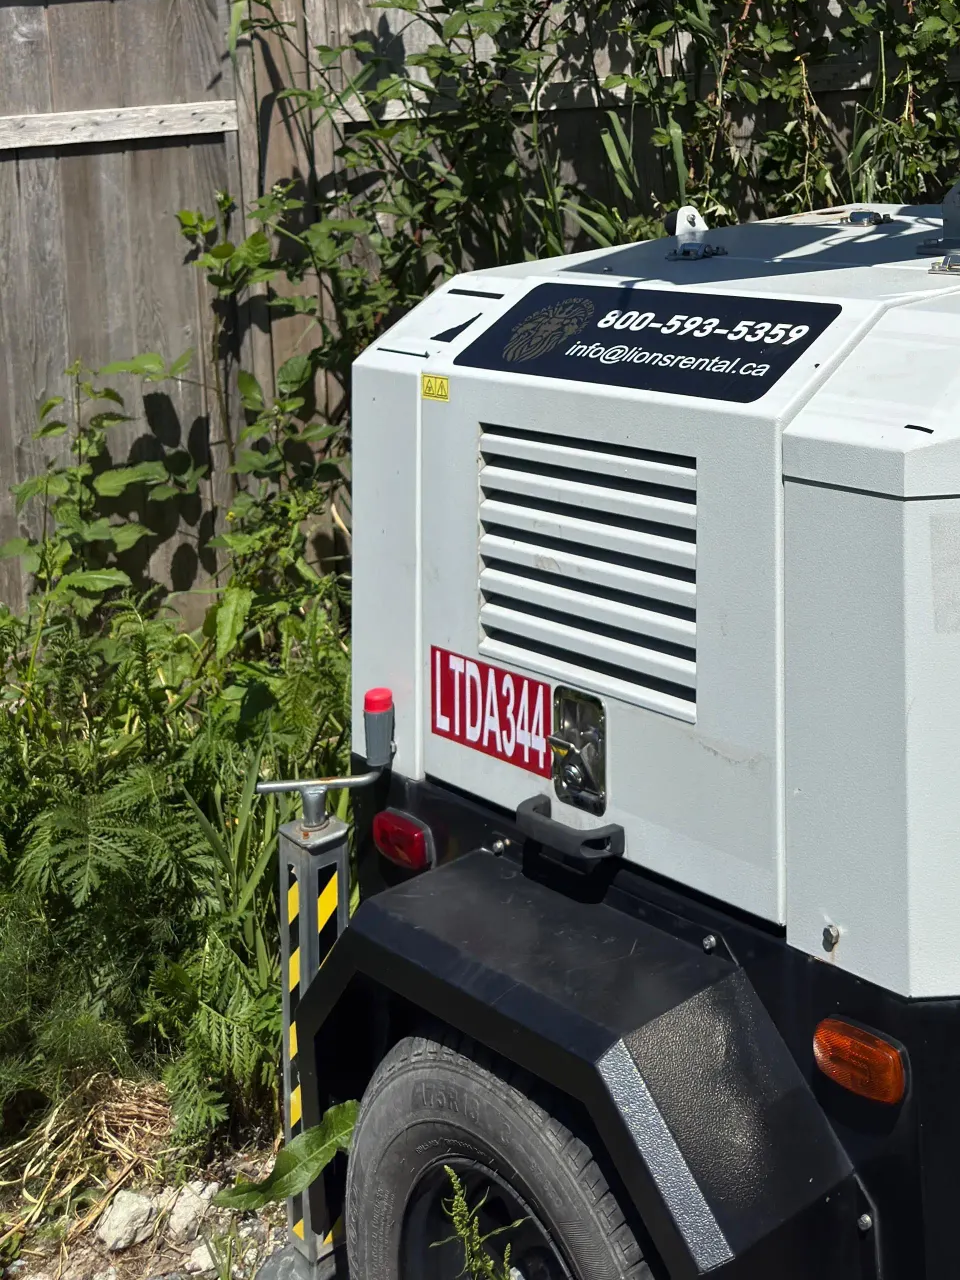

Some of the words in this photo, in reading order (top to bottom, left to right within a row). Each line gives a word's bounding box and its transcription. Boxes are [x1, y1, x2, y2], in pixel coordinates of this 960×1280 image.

[597, 309, 810, 346] 800-593-5359
[565, 340, 770, 377] info@lionsrental.ca
[435, 650, 547, 769] LTDA344
